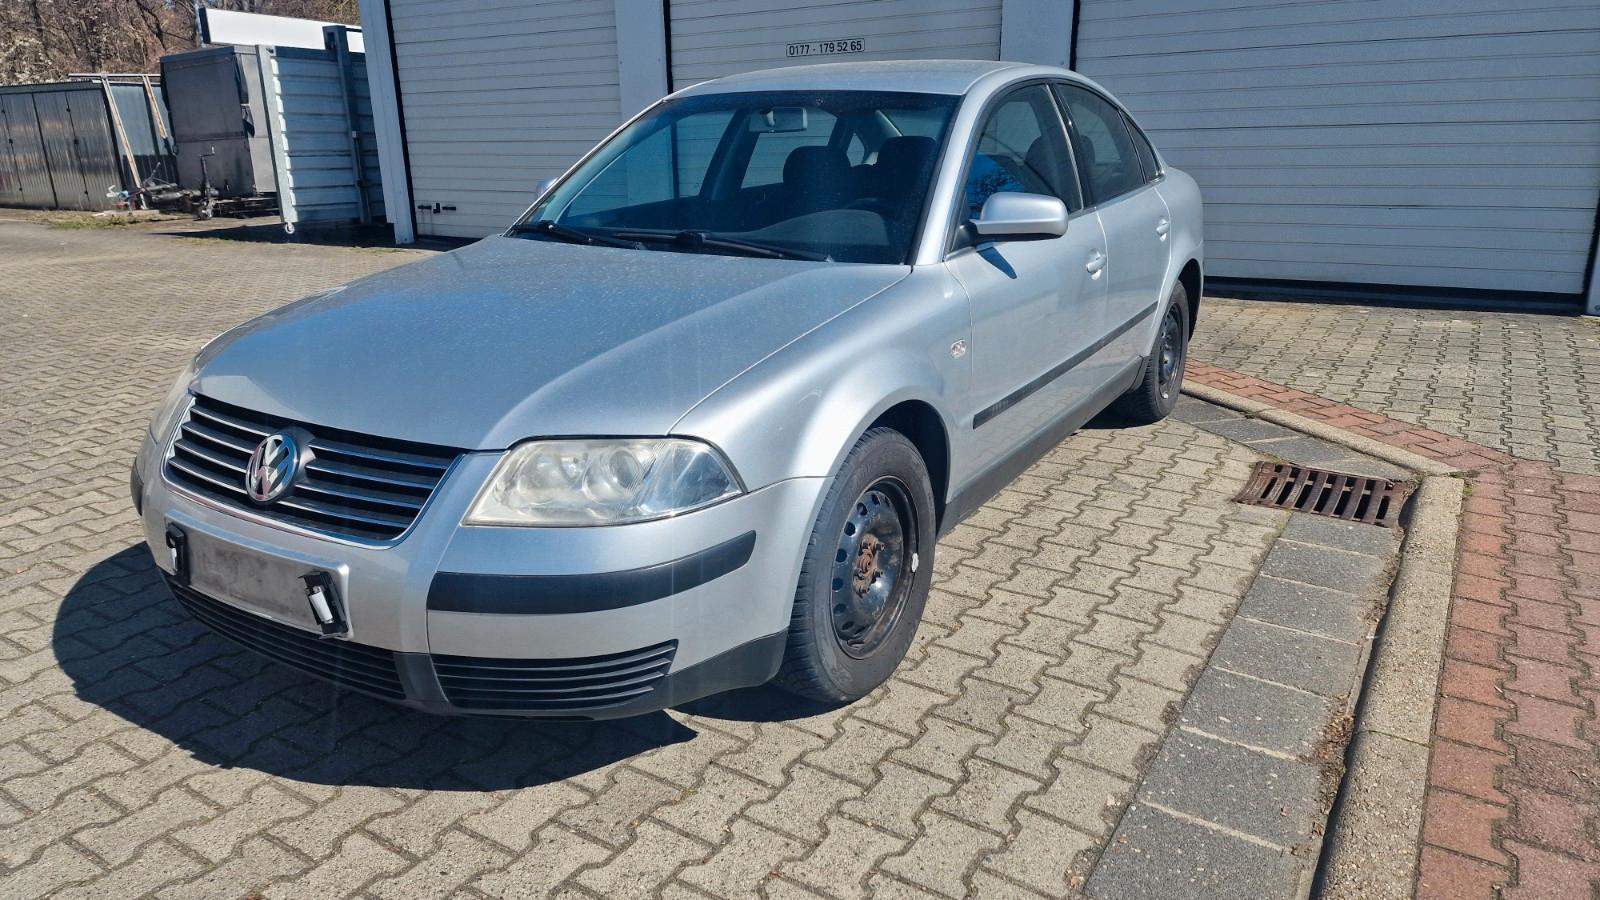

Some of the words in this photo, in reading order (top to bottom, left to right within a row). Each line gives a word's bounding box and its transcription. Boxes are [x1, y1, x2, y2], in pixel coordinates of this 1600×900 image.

[789, 44, 810, 55] 0177
[819, 42, 835, 53] 179
[837, 41, 848, 52] 52
[850, 40, 862, 51] 65
